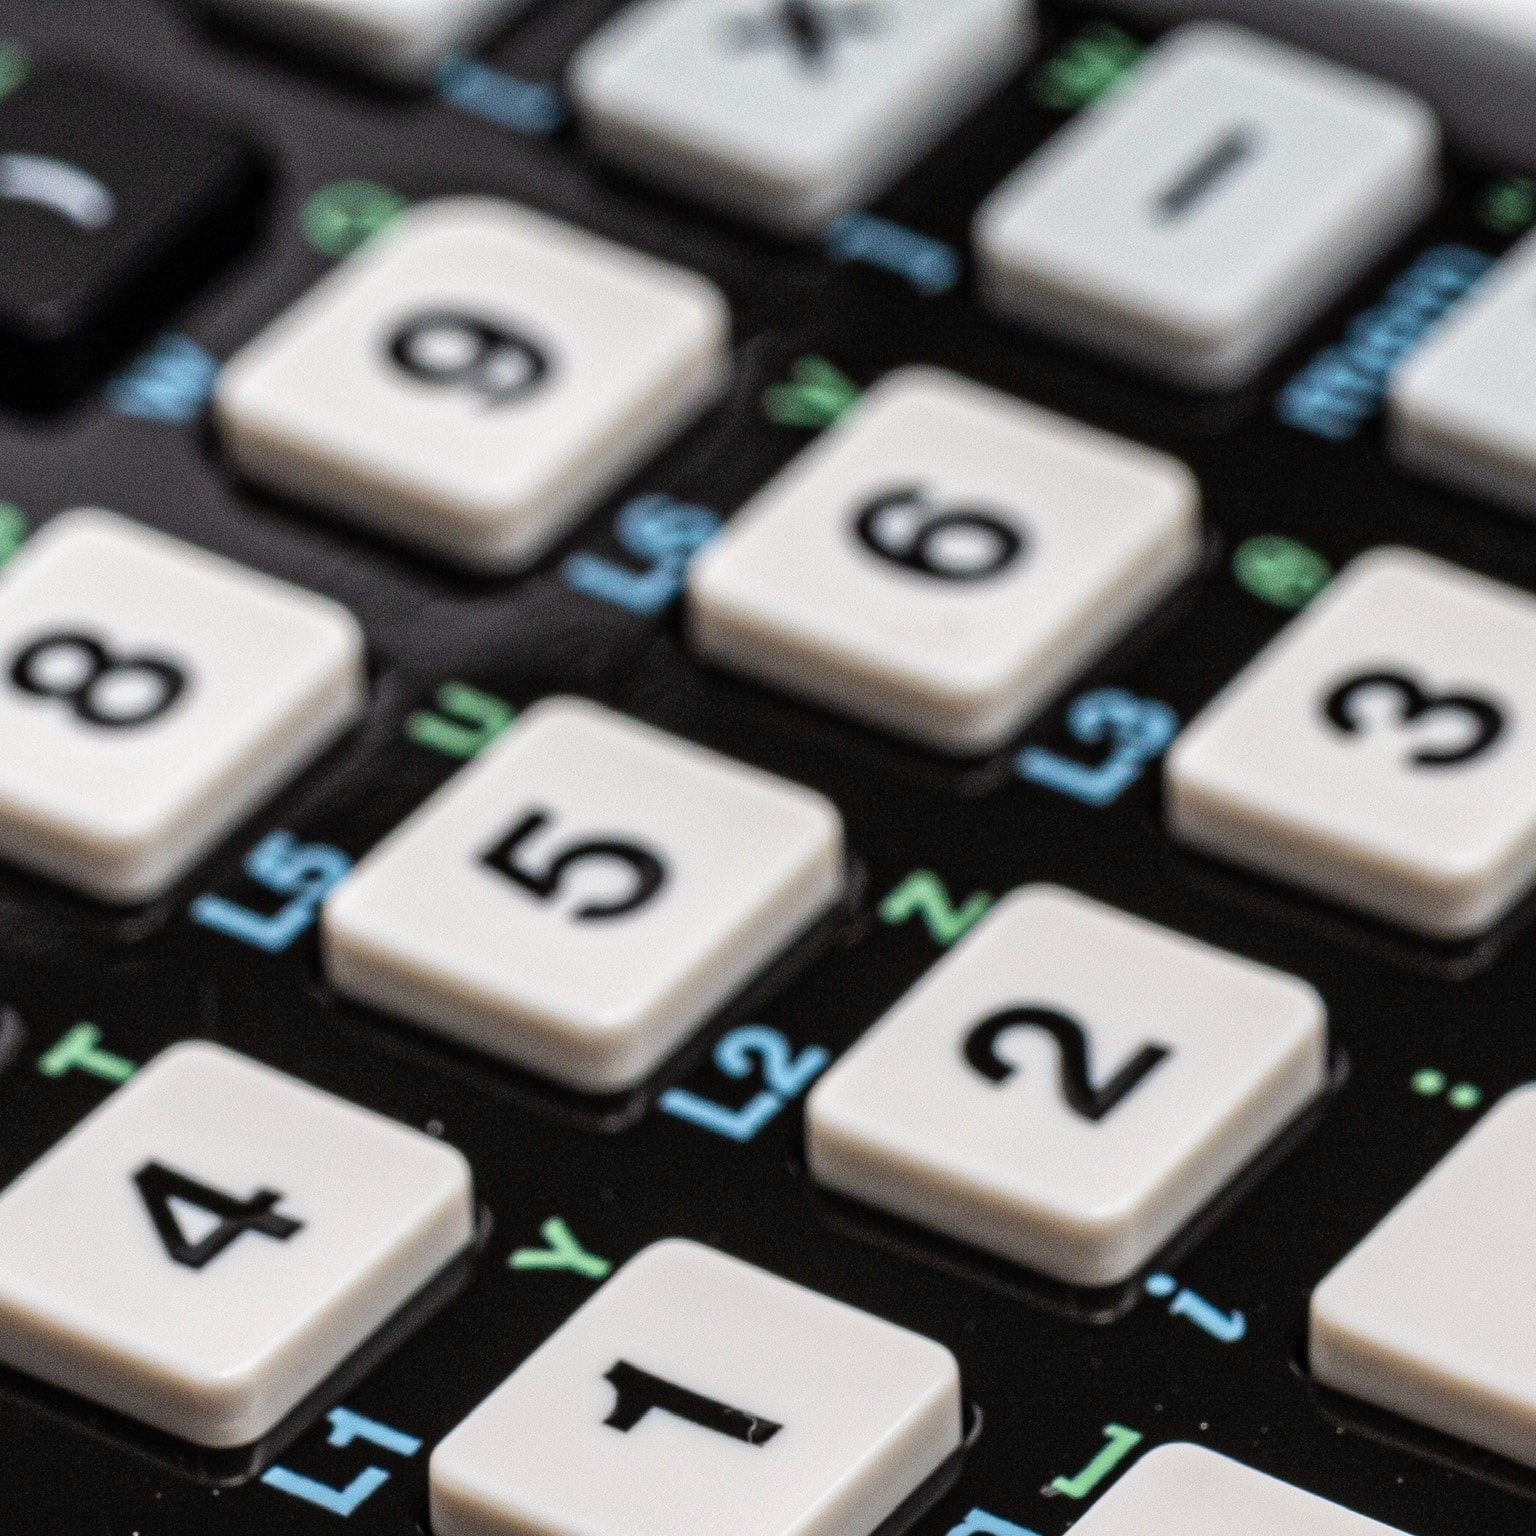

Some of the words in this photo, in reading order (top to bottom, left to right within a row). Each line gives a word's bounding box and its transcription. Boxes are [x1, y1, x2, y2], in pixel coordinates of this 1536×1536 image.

[380, 309, 555, 405] 9
[569, 500, 722, 613] L6
[848, 486, 1029, 586] 6
[3, 629, 191, 733] 8
[412, 685, 516, 759] U
[1318, 667, 1509, 771] 3
[1019, 690, 1177, 804] L3
[194, 833, 352, 952] L5
[477, 809, 669, 923] 5
[884, 871, 992, 945] Z
[40, 1024, 137, 1084] T
[660, 1025, 828, 1141] L2
[960, 1004, 1170, 1124] 2
[132, 1160, 303, 1271] 4
[513, 1219, 610, 1279] Y
[1146, 1272, 1247, 1341] i
[604, 1360, 782, 1446] 1
[263, 1406, 422, 1515] L1
